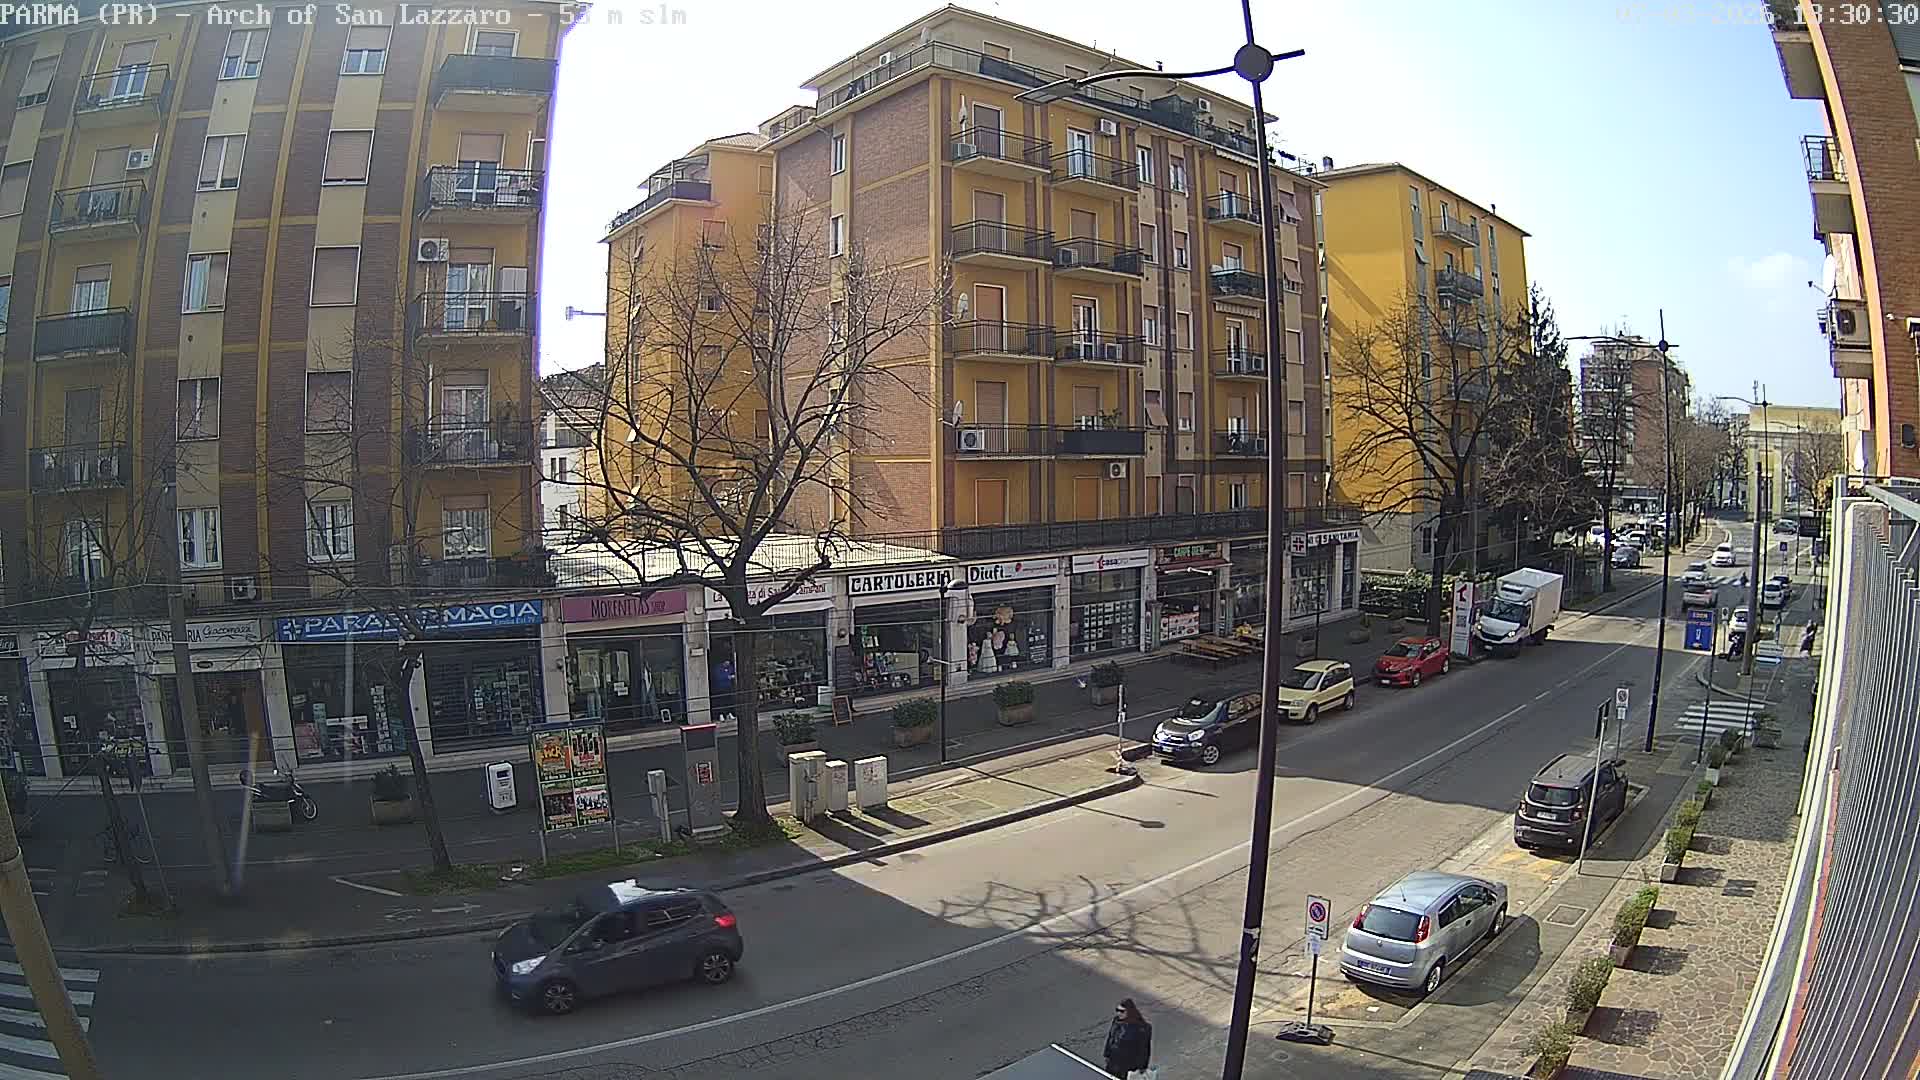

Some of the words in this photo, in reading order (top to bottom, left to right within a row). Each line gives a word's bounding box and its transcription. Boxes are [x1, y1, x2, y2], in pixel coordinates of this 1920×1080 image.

[851, 569, 953, 592] CARTOLERIA
[305, 602, 539, 633] PARAFRMACIA
[591, 599, 650, 618] MORENITAS
[151, 629, 202, 643] PANERIA
